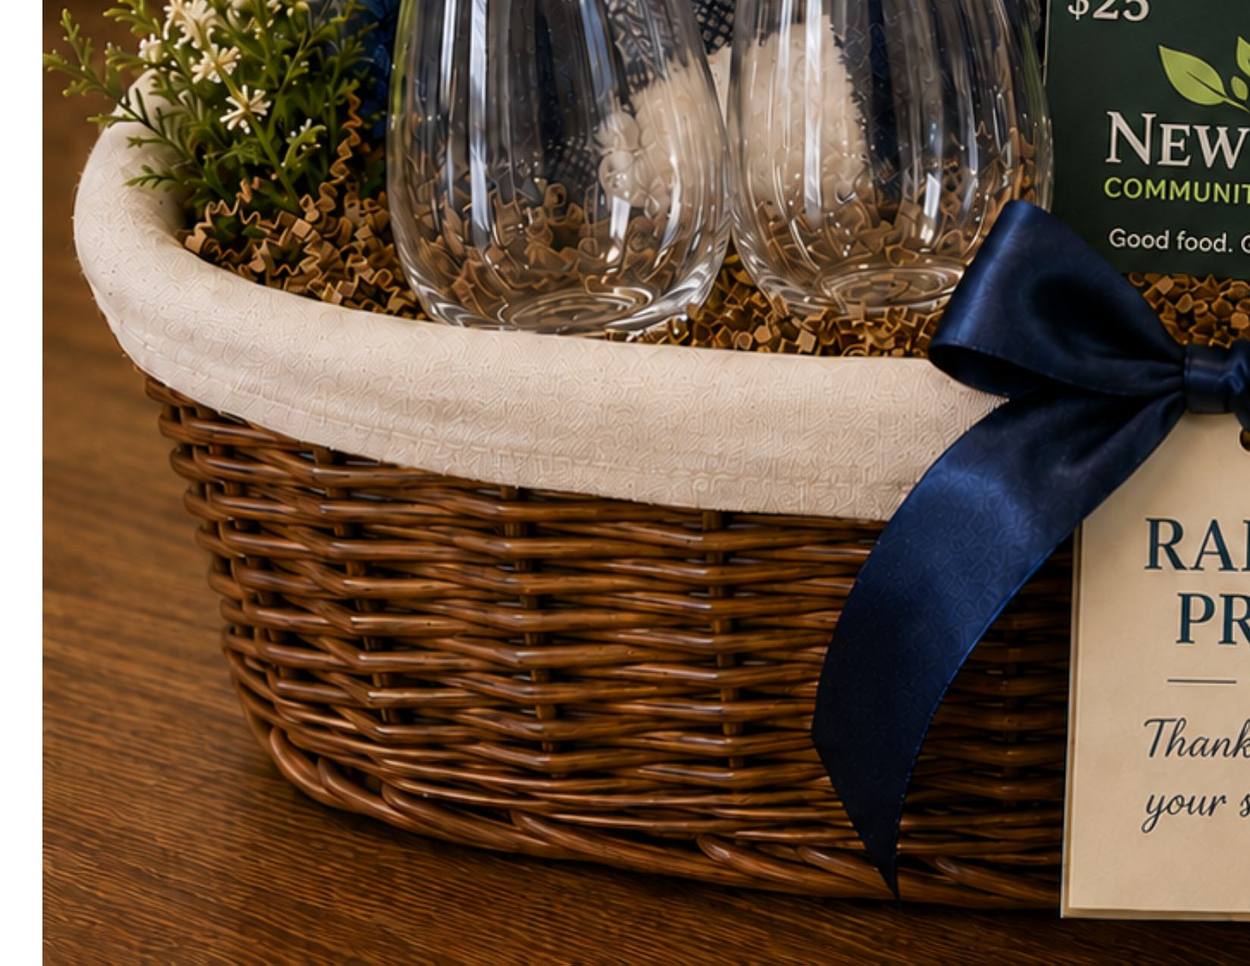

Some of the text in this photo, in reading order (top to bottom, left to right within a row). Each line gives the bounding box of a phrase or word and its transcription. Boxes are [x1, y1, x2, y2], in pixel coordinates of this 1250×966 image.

[1105, 111, 1250, 170] NEW
[1108, 228, 1170, 251] Good
[1176, 231, 1233, 253] food.
[1141, 792, 1227, 834] your
